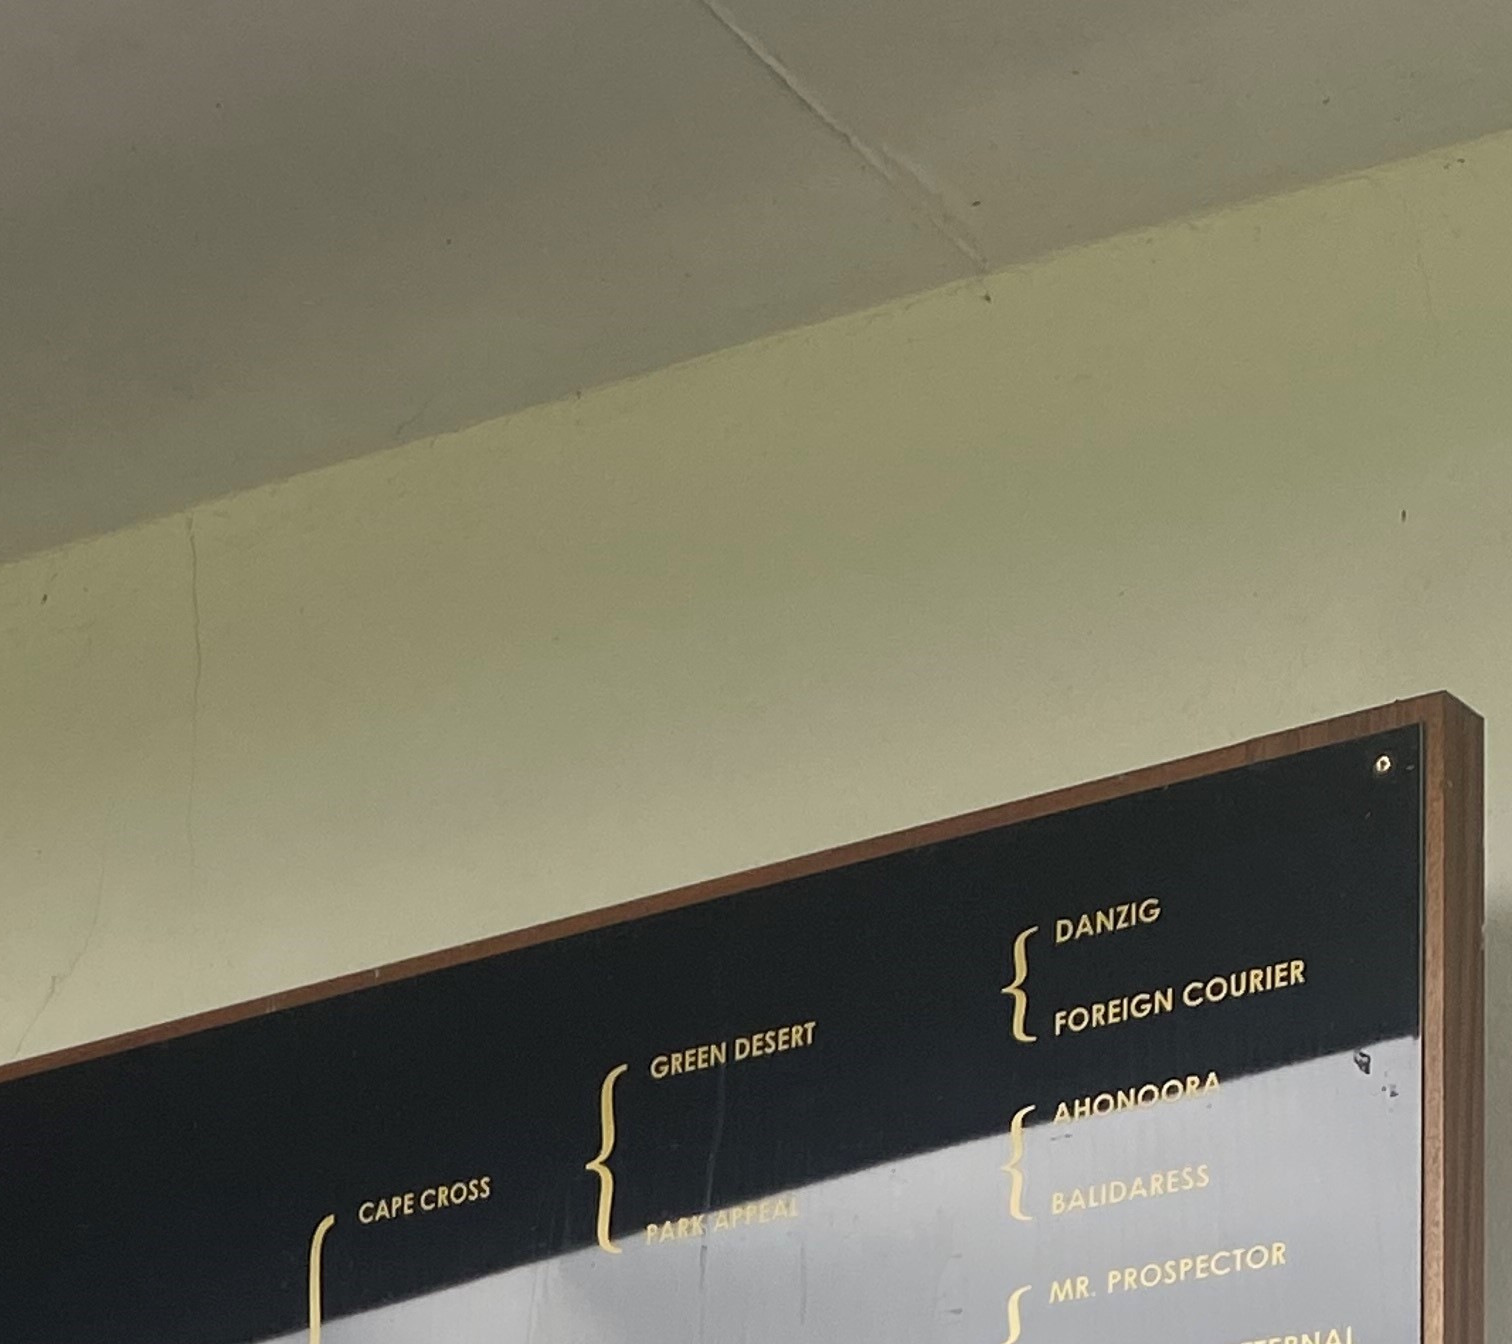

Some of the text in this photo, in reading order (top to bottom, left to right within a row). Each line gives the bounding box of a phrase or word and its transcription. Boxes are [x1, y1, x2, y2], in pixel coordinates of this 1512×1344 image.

[1055, 899, 1160, 944] DANZIG
[1055, 960, 1304, 1035] FOREIGN COURIER
[651, 1021, 815, 1079] GREEN DESERT
[1052, 1073, 1222, 1126] AHONOORA
[357, 1176, 491, 1224] CAPE CROSS
[1049, 1165, 1209, 1216] BALIDARESS
[645, 1194, 800, 1246] PARK APPEAL
[1049, 1242, 1287, 1304] MR. PROSPECTOR
